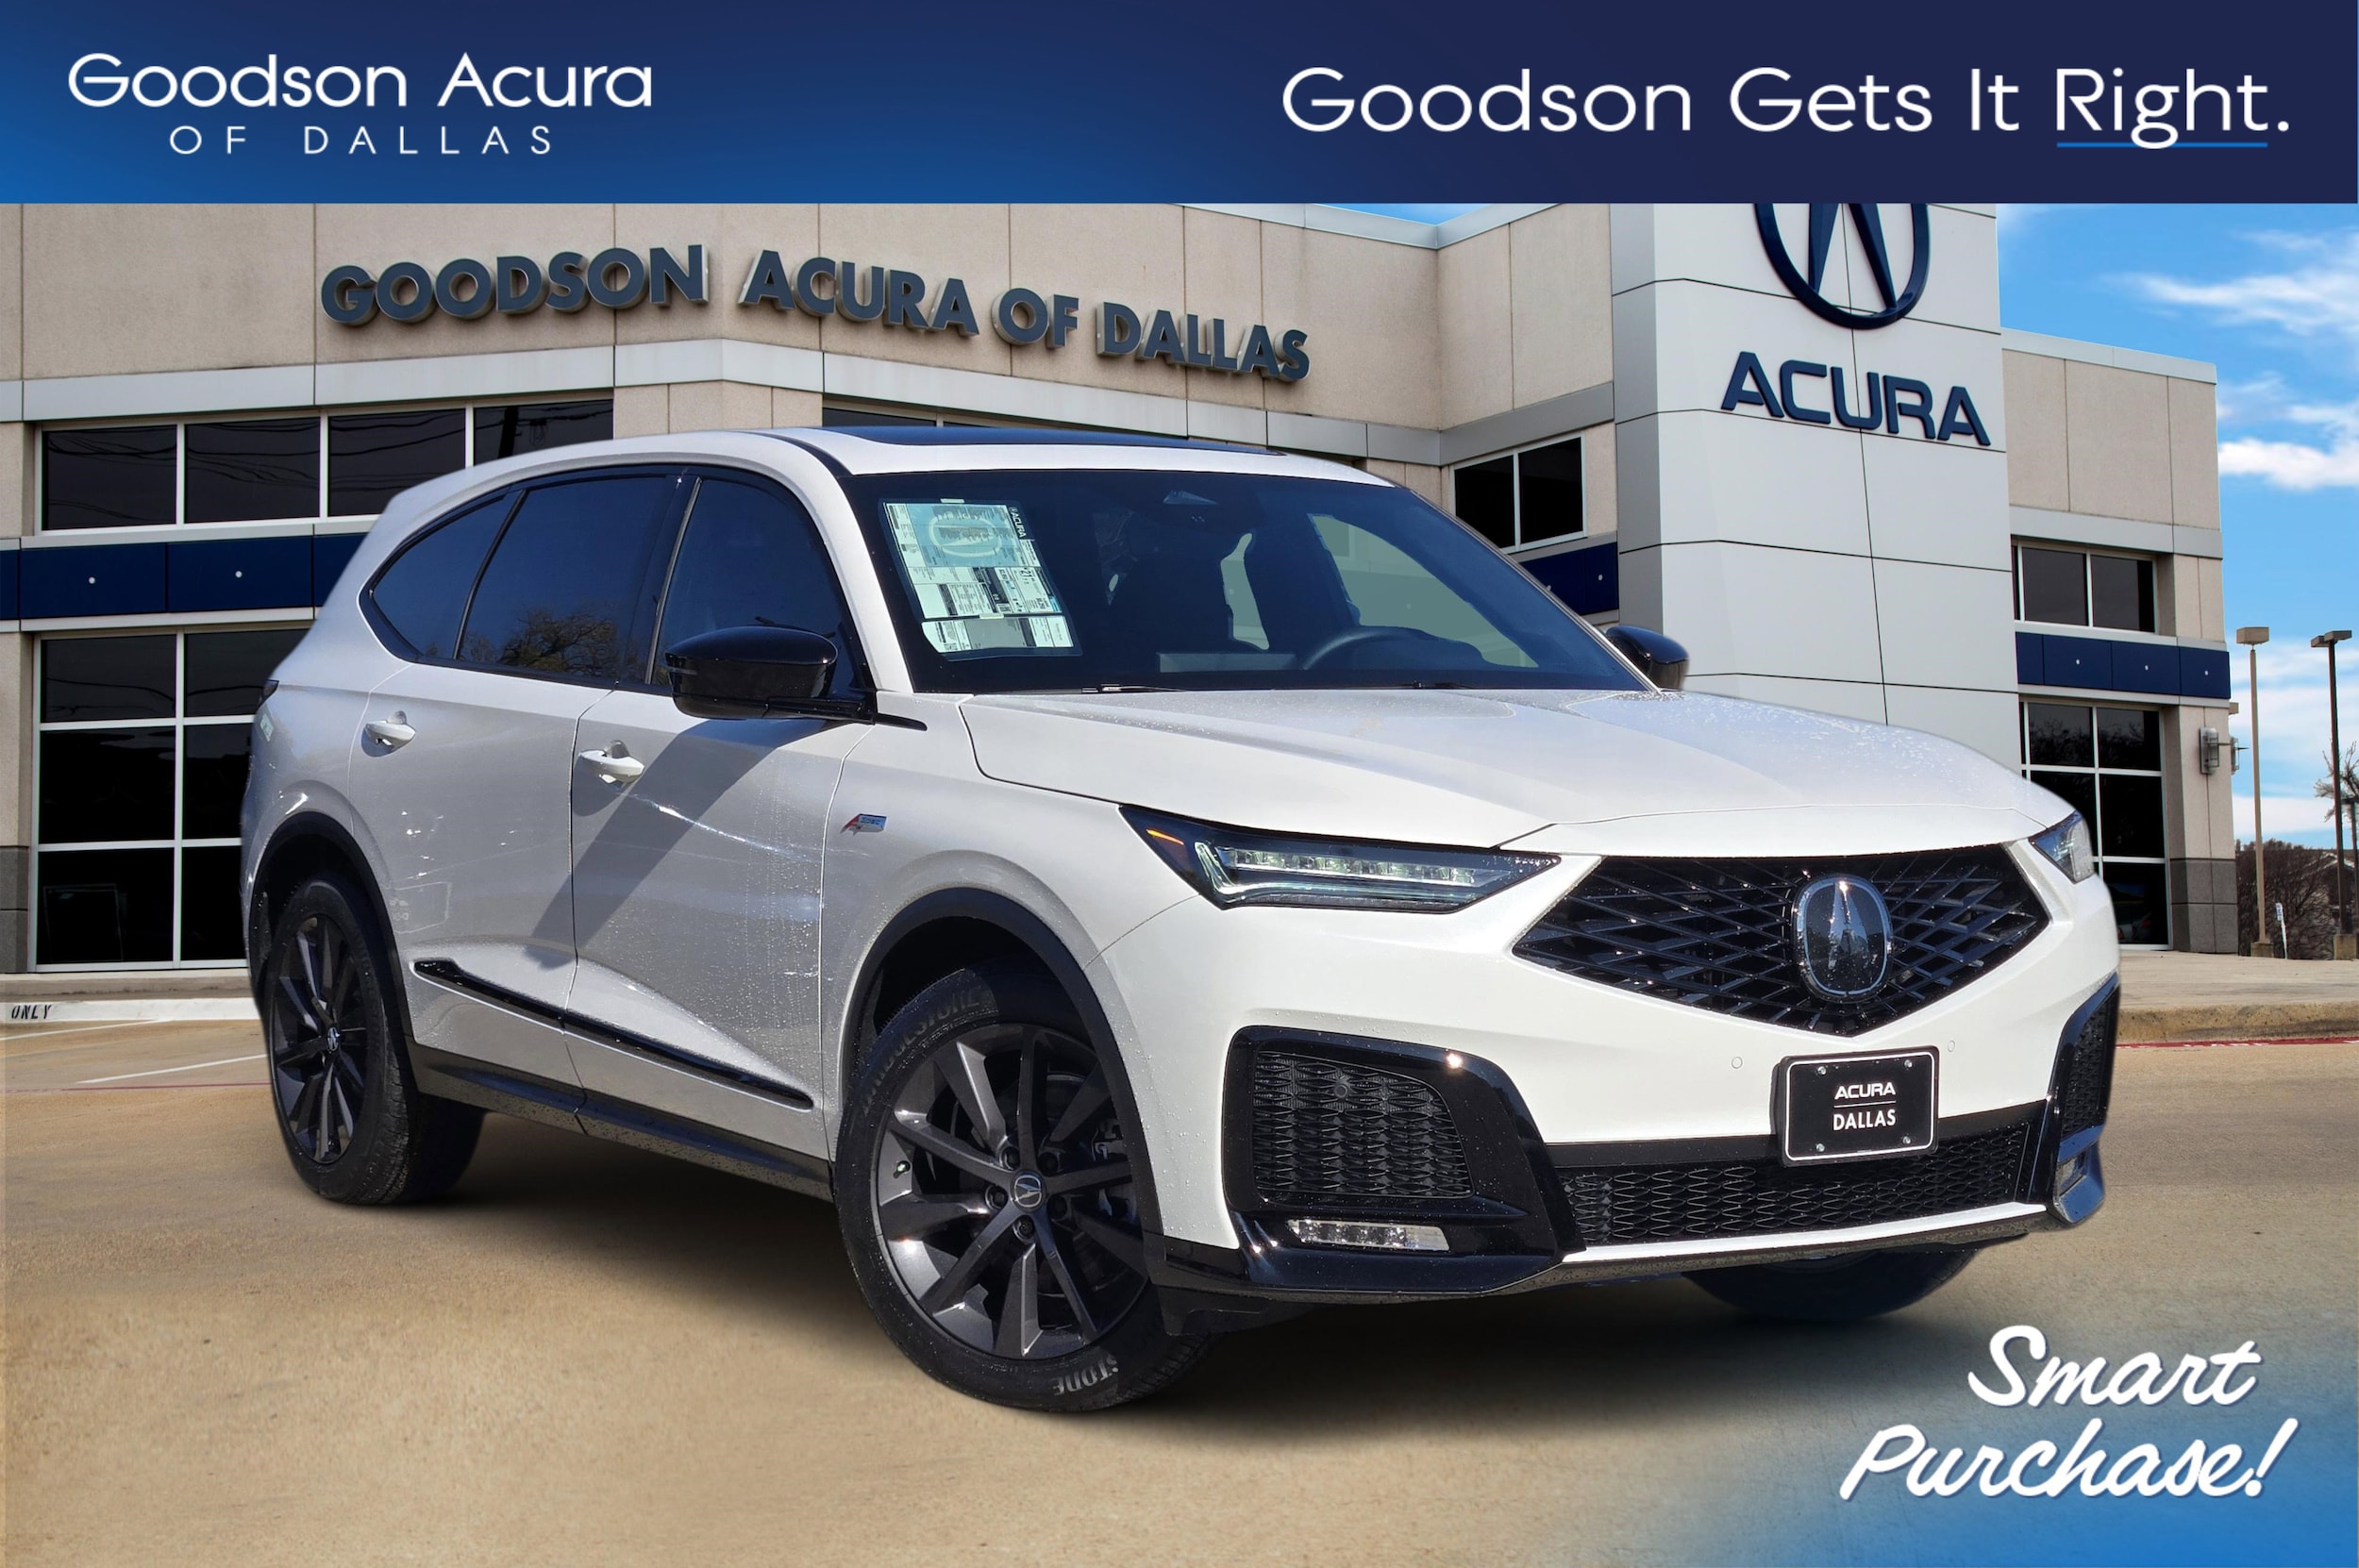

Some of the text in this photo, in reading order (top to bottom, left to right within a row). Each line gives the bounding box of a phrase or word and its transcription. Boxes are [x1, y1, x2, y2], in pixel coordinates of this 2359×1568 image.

[321, 244, 1311, 382] GOODSON ACURA OF DALLAS
[1720, 351, 1991, 446] ACURA
[1011, 512, 1027, 538] ACURA
[11, 1005, 53, 1020] ONLY
[1834, 1082, 1897, 1100] ACURA
[1833, 1109, 1897, 1131] DALLAS
